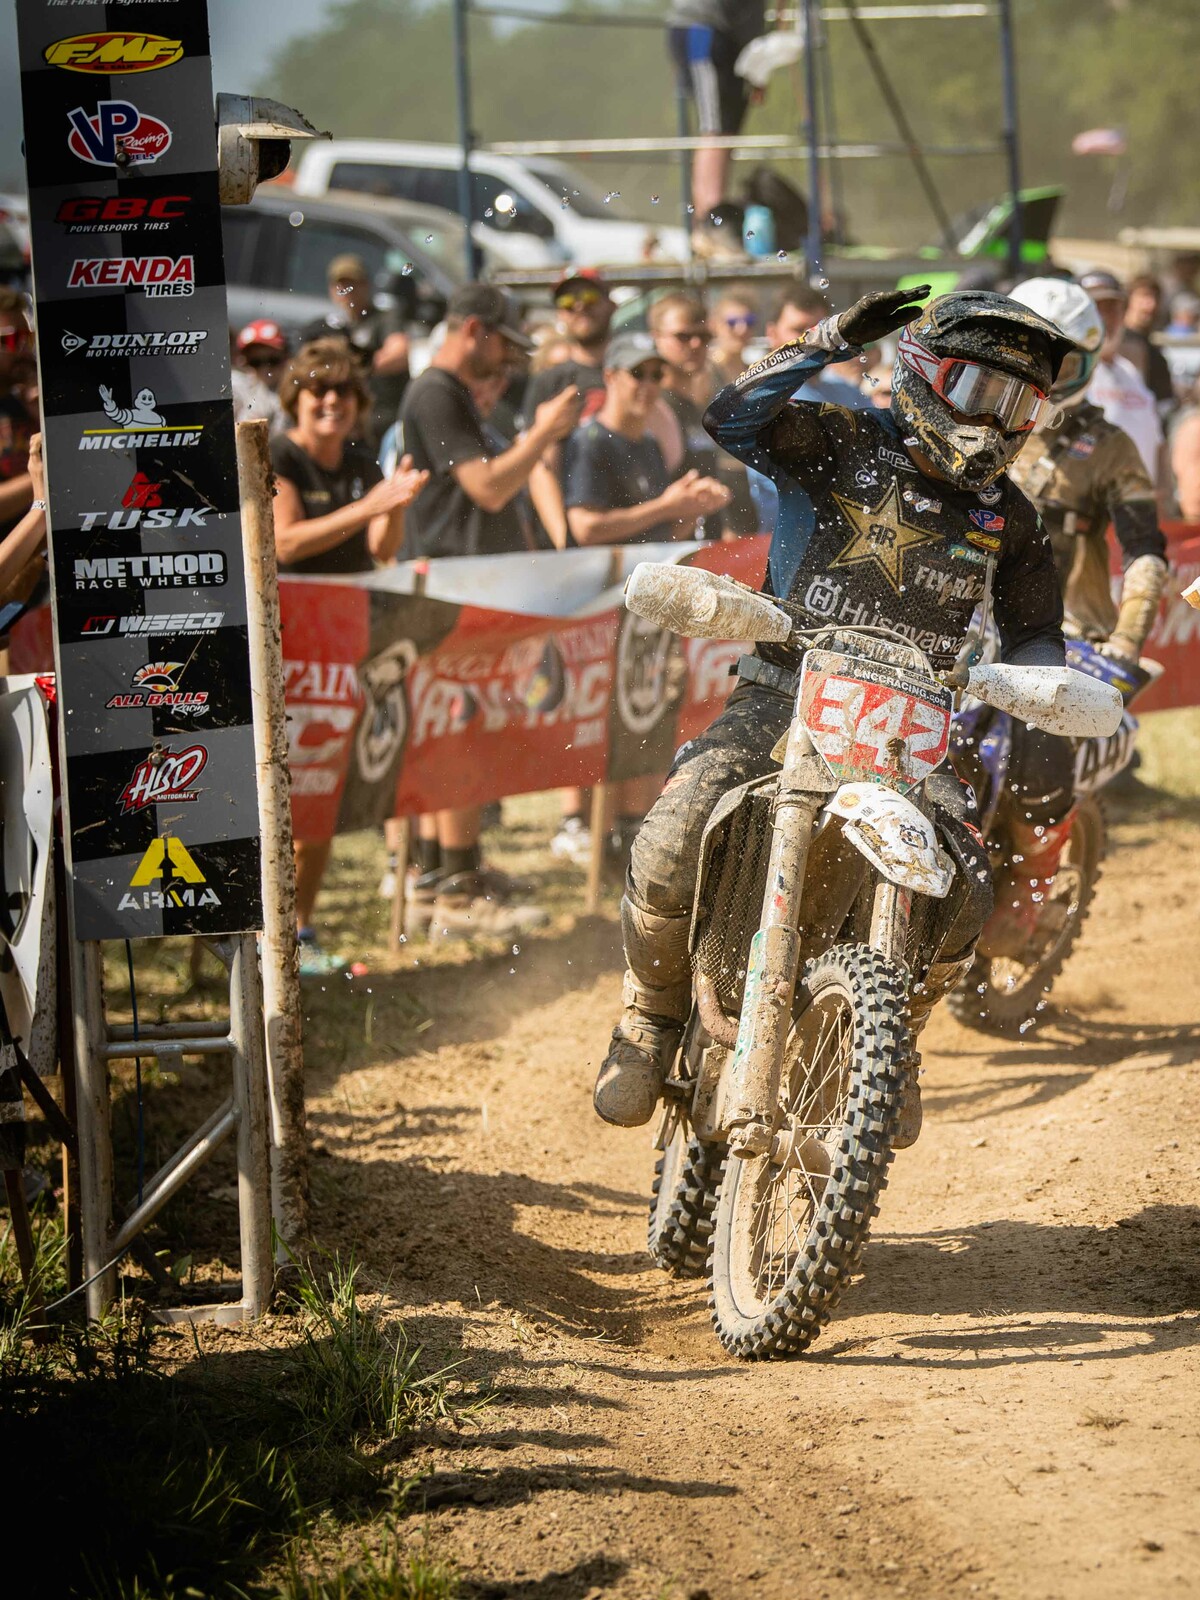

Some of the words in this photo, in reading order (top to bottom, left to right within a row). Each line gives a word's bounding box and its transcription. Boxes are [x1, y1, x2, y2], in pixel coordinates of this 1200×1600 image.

[47, 36, 182, 64] FMF
[67, 100, 140, 164] VP
[127, 152, 155, 160] UELS
[58, 196, 192, 221] GBC
[70, 223, 138, 233] POWERSPORTS
[143, 222, 170, 230] TIRES
[67, 255, 195, 288] KENDA
[145, 283, 194, 297] TIRES
[88, 331, 208, 349] DUNLOP
[86, 347, 160, 357] MOTORCYCLE
[165, 345, 198, 354] TIRES
[735, 360, 768, 386] ENERGY
[769, 346, 801, 367] DRINK
[78, 432, 202, 450] MICHELIN
[78, 507, 214, 531] TUSK
[74, 553, 224, 580] METHOD
[75, 579, 127, 590] RACE
[139, 574, 225, 587] WHEELS
[914, 565, 951, 592] FLY
[124, 631, 176, 639] Performance
[178, 629, 215, 637] Products
[838, 597, 965, 653] Husqvarna
[106, 694, 144, 708] ALL
[146, 692, 209, 706] BALLS
[171, 703, 210, 717] Racing
[117, 887, 222, 911] ARMA
